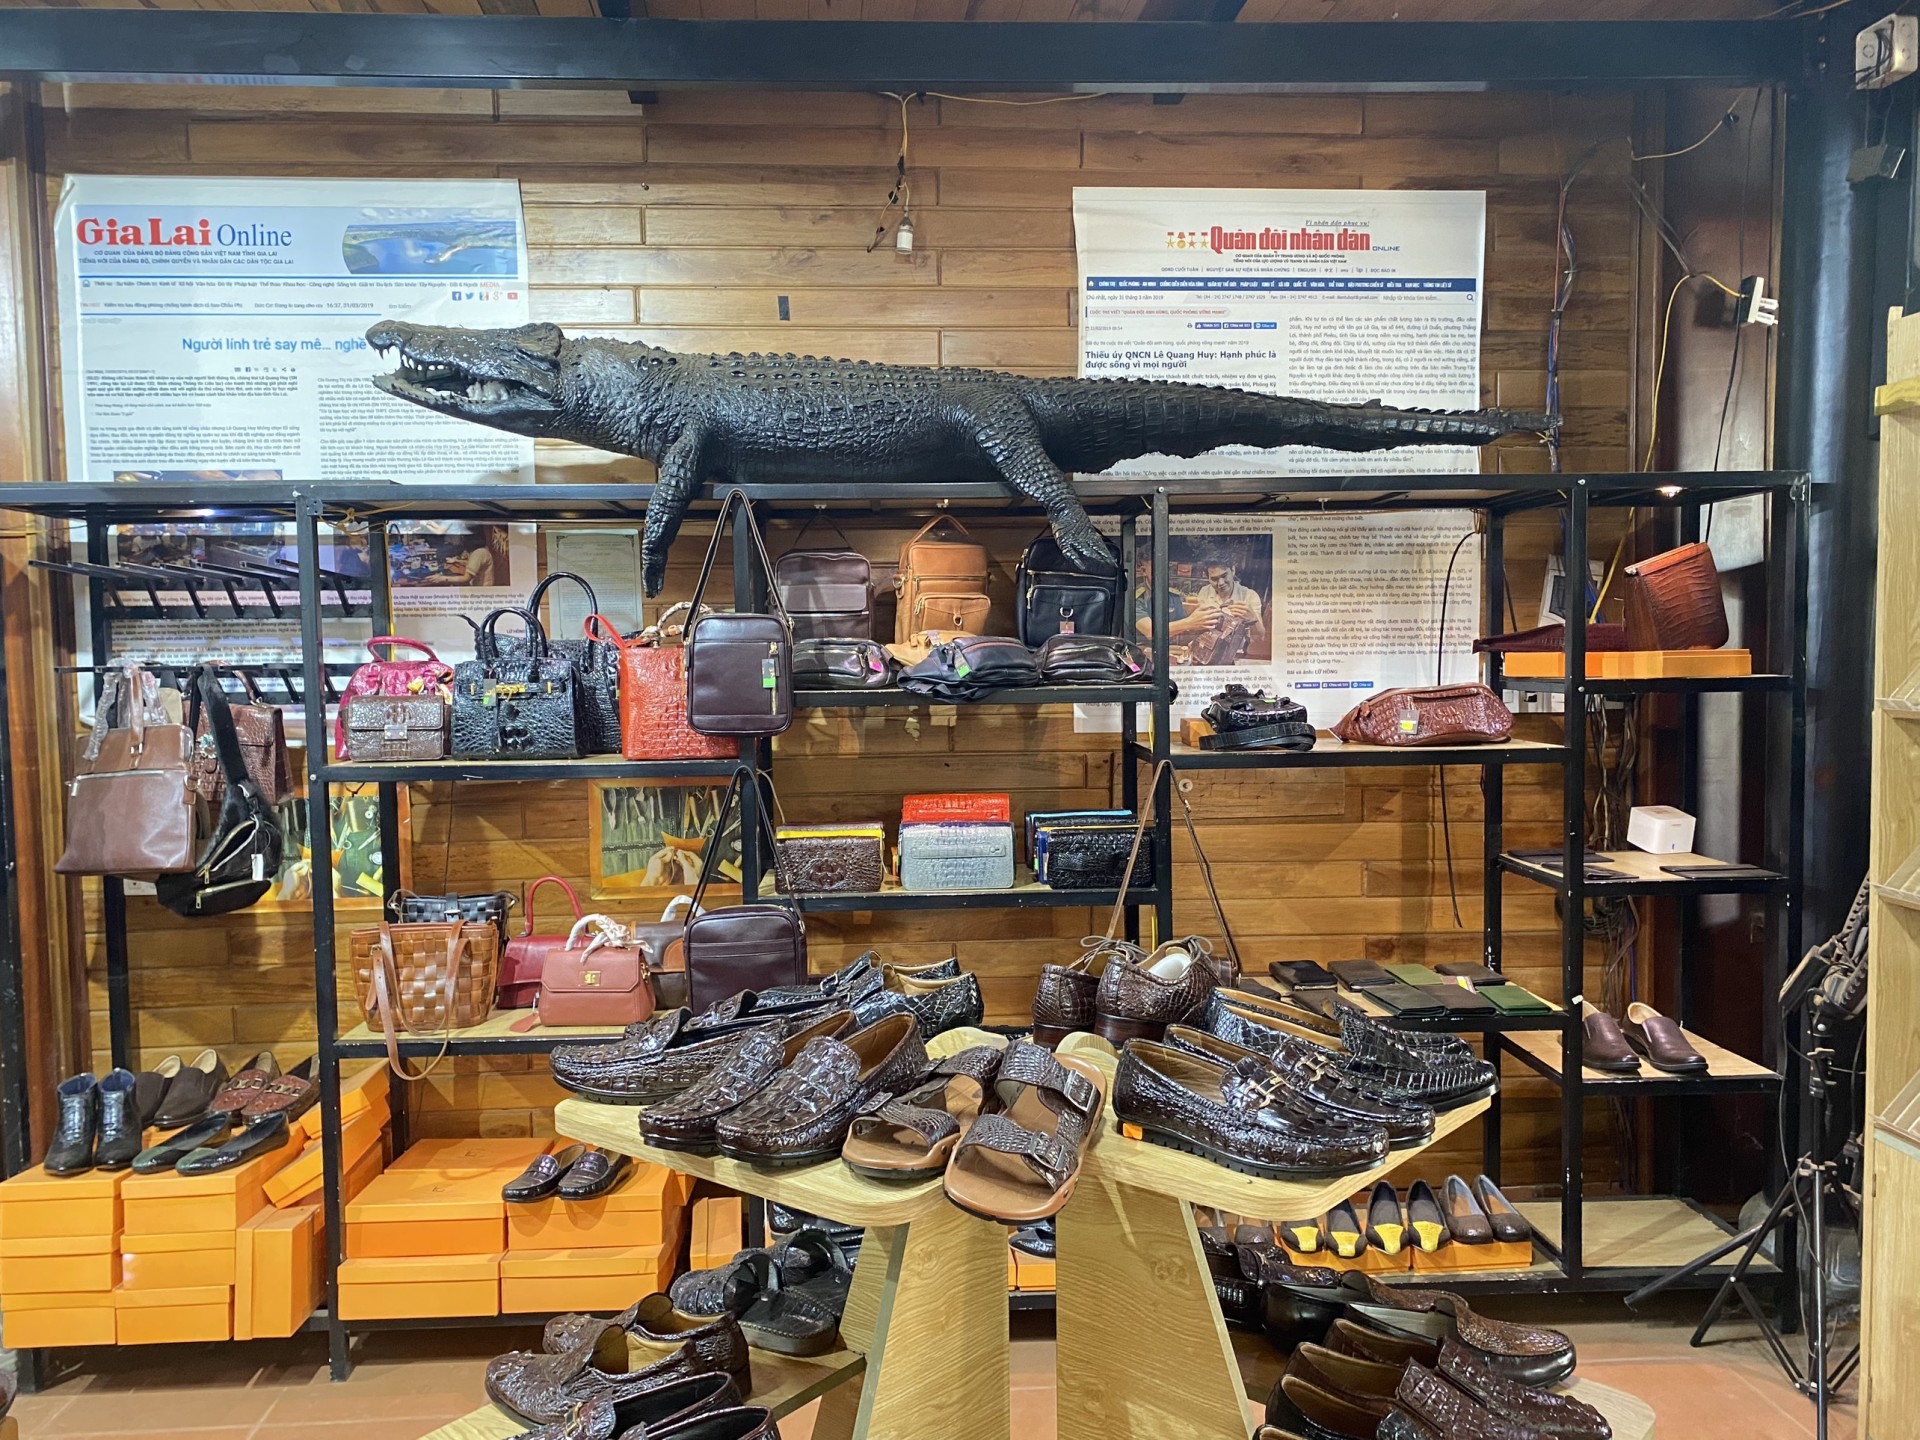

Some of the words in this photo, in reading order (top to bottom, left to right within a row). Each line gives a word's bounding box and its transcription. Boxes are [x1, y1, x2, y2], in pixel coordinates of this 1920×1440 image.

[77, 218, 144, 246] Gia
[148, 218, 211, 246] Lai
[217, 224, 292, 247] Online
[1210, 226, 1256, 254] Quân
[1259, 228, 1287, 253] đội
[1290, 228, 1334, 250] nhân
[1337, 228, 1370, 251] dân
[182, 338, 222, 352] Người
[226, 338, 250, 350] lính
[253, 337, 271, 350] trẻ
[275, 340, 297, 353] say
[335, 338, 367, 353] nghề
[1112, 351, 1122, 360] úy
[1125, 352, 1150, 360] QNCN
[1166, 352, 1195, 361] Quang
[1197, 352, 1218, 361] Huy:
[1220, 351, 1242, 360] Hạnh
[1245, 351, 1266, 360] phúc
[1086, 361, 1107, 369] được
[1110, 361, 1130, 370] sống
[1143, 361, 1159, 369] mọi
[1161, 361, 1187, 370] người
